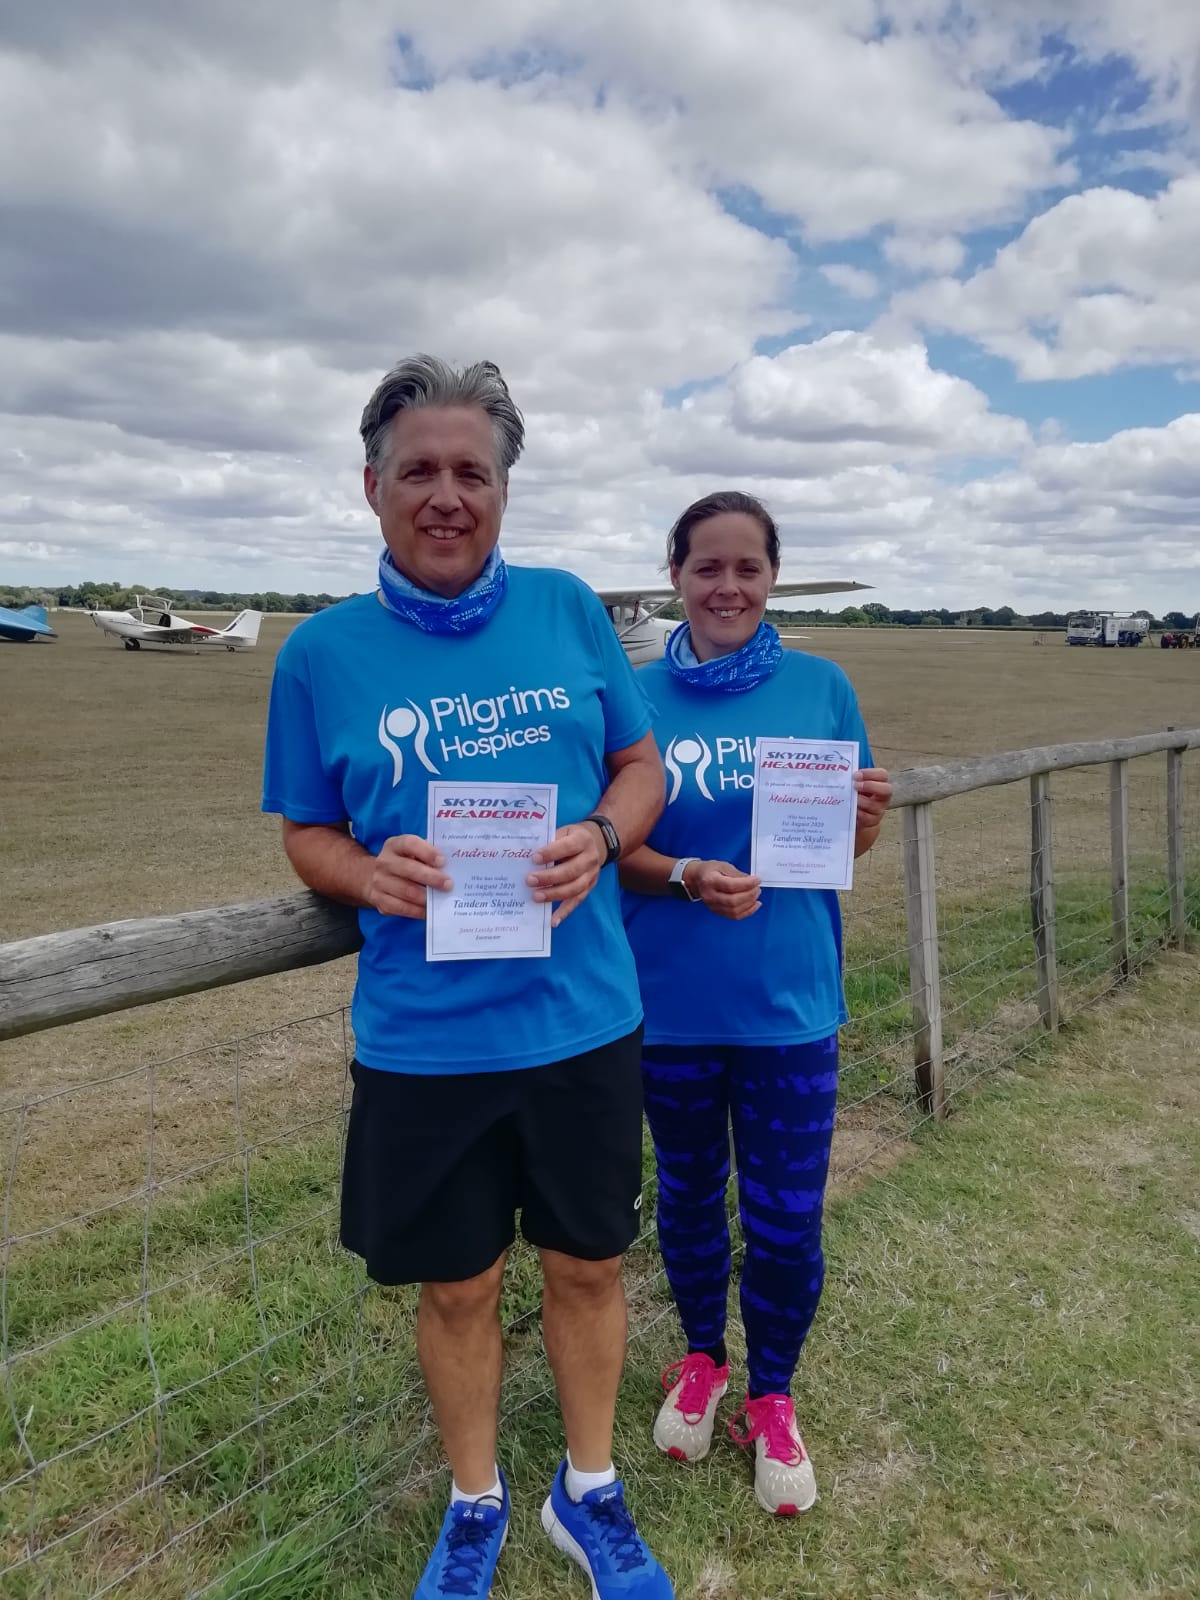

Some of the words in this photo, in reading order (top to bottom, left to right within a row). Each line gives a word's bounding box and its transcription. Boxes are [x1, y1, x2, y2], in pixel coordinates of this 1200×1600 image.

[430, 686, 571, 734] Pilgrims
[440, 724, 552, 762] Hospices
[715, 736, 757, 765] Pil
[766, 751, 835, 762] SKYDIVE
[761, 760, 850, 772] HEADCORN
[441, 797, 528, 808] SKYDIVE
[768, 792, 810, 804] Melanie
[811, 796, 845, 806] Fuller
[436, 809, 546, 820] HEADCORN
[773, 834, 801, 842] Tandem
[802, 835, 833, 845] Skydive
[451, 847, 499, 858] Andrew
[501, 847, 534, 858] Todd
[475, 882, 498, 890] August
[453, 899, 489, 909] Tandem
[490, 899, 526, 910] Skydive
